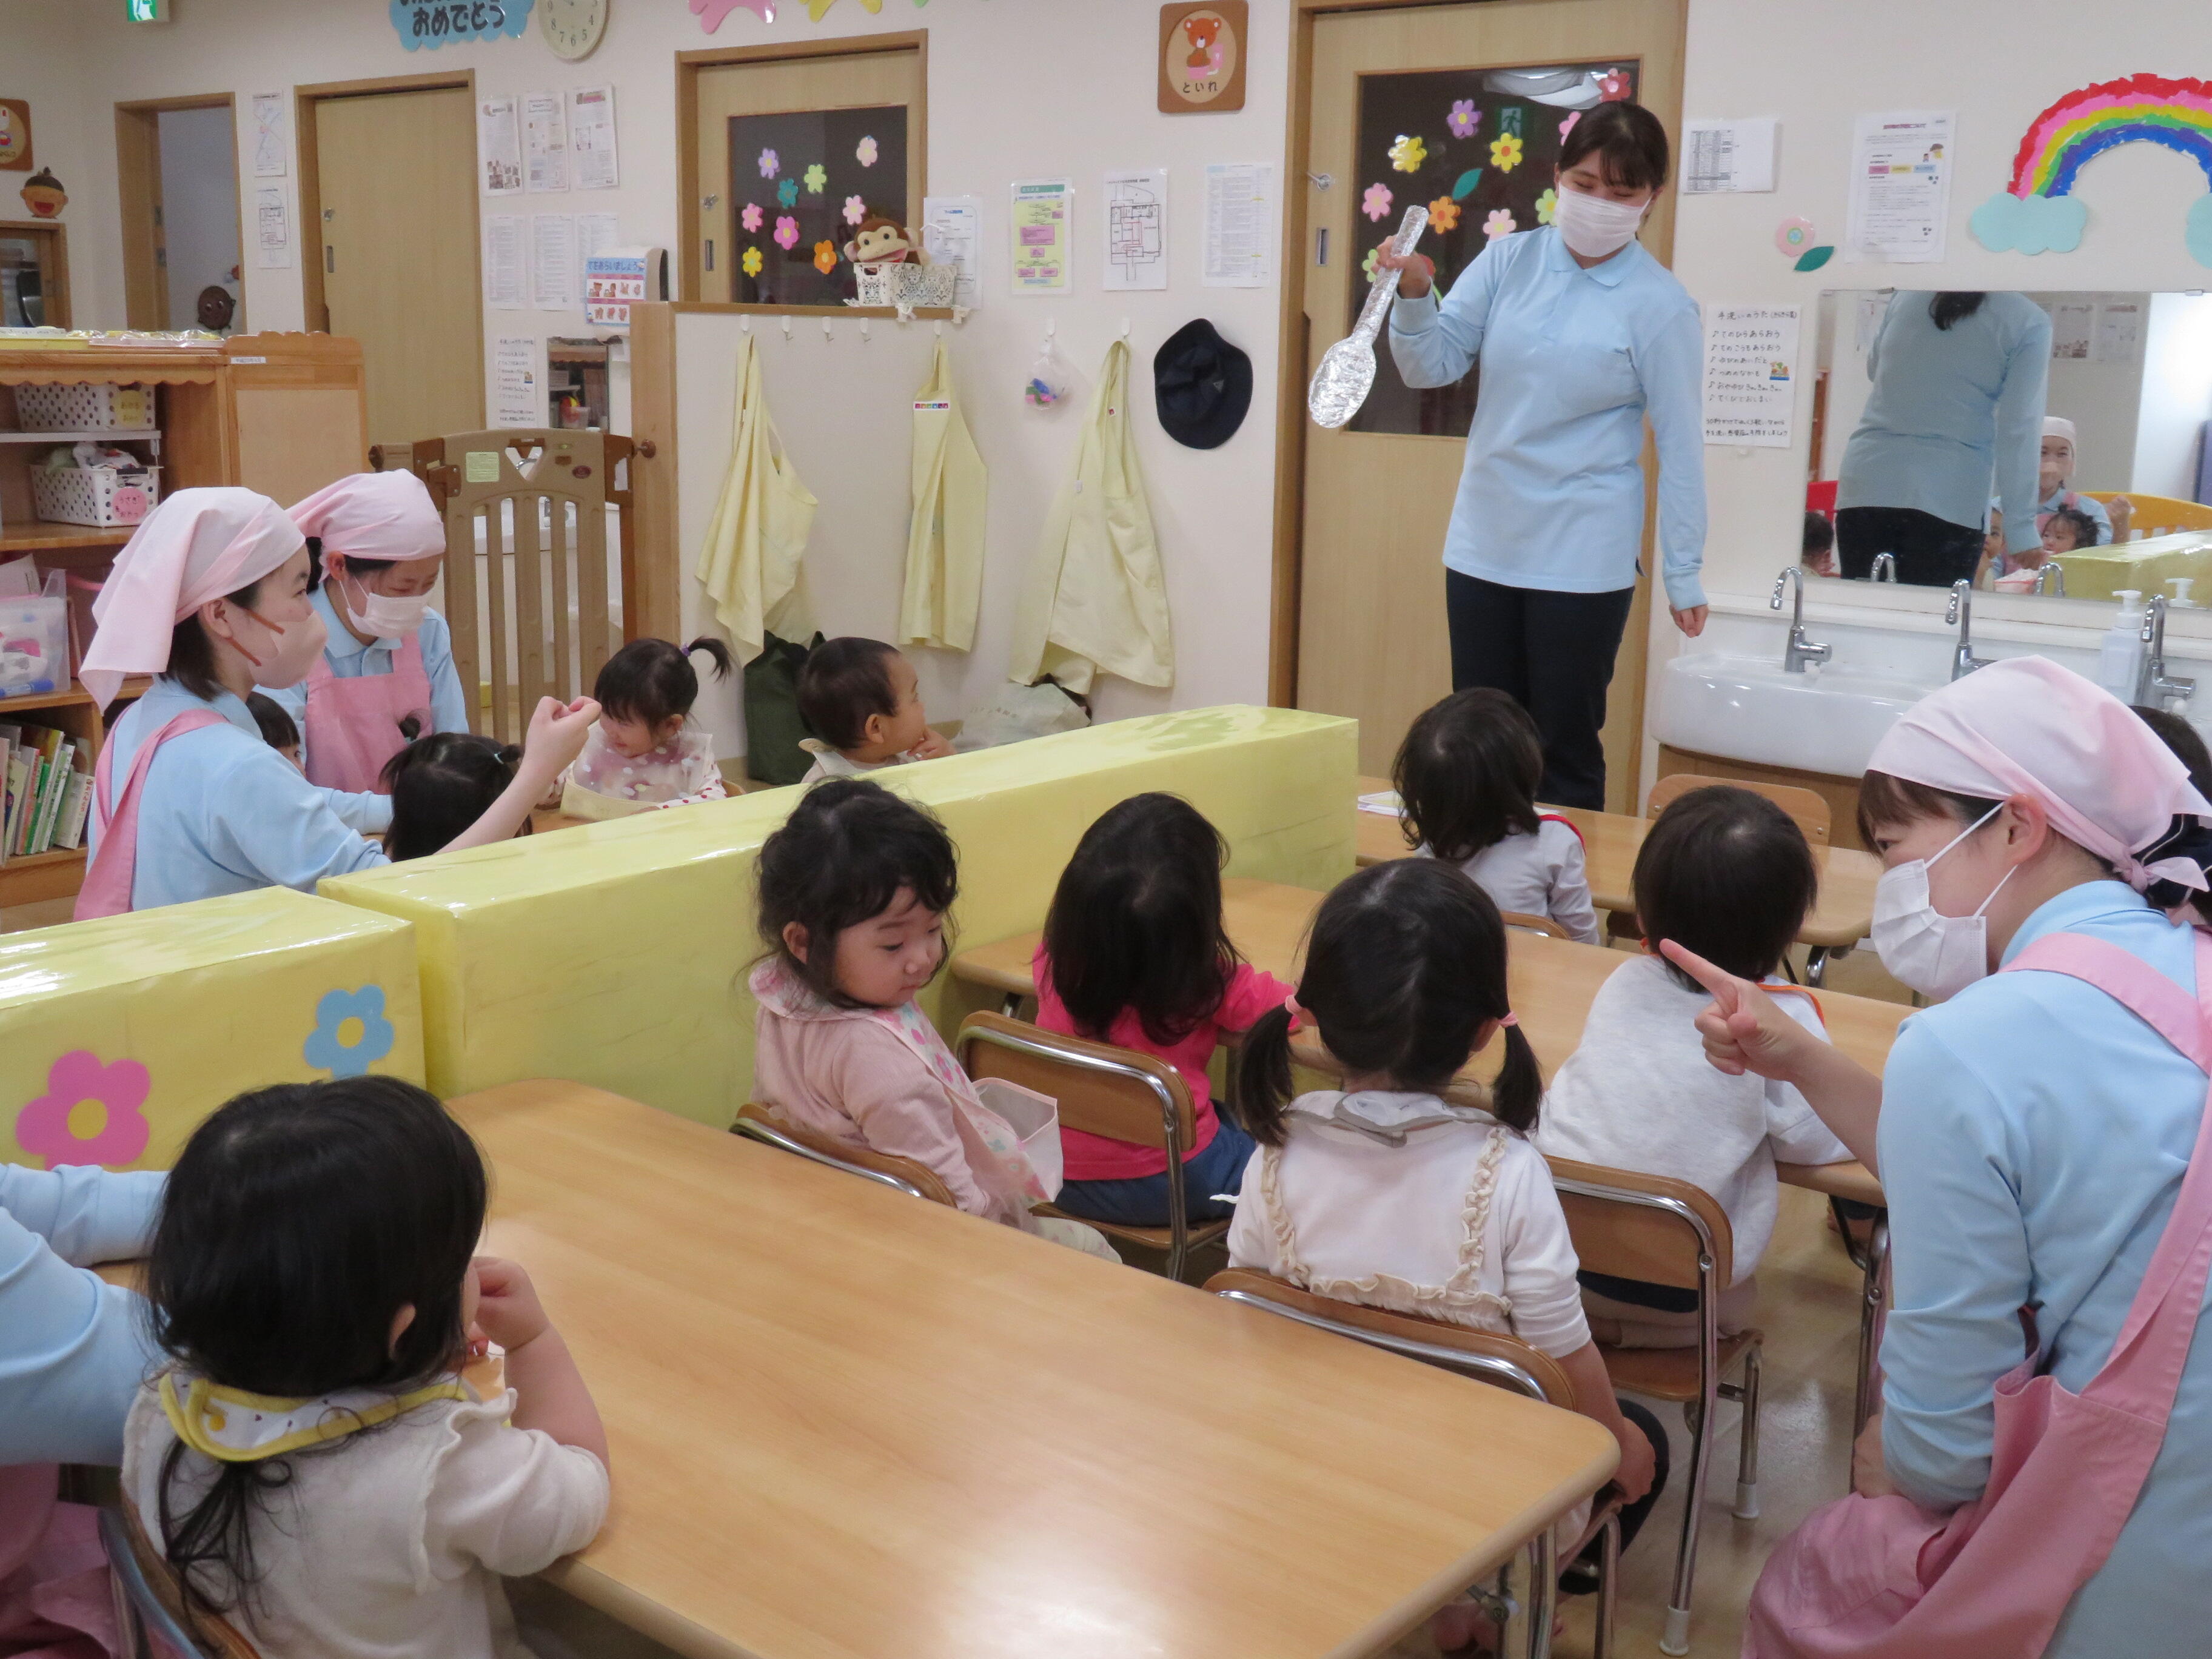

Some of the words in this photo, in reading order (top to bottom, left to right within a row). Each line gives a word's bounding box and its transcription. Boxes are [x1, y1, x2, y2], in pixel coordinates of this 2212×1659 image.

[551, 18, 556, 30] 8
[588, 15, 594, 25] 4
[560, 31, 565, 43] 7
[571, 34, 576, 47] 6
[582, 28, 587, 41] 5
[1182, 81, 1218, 93] といれ
